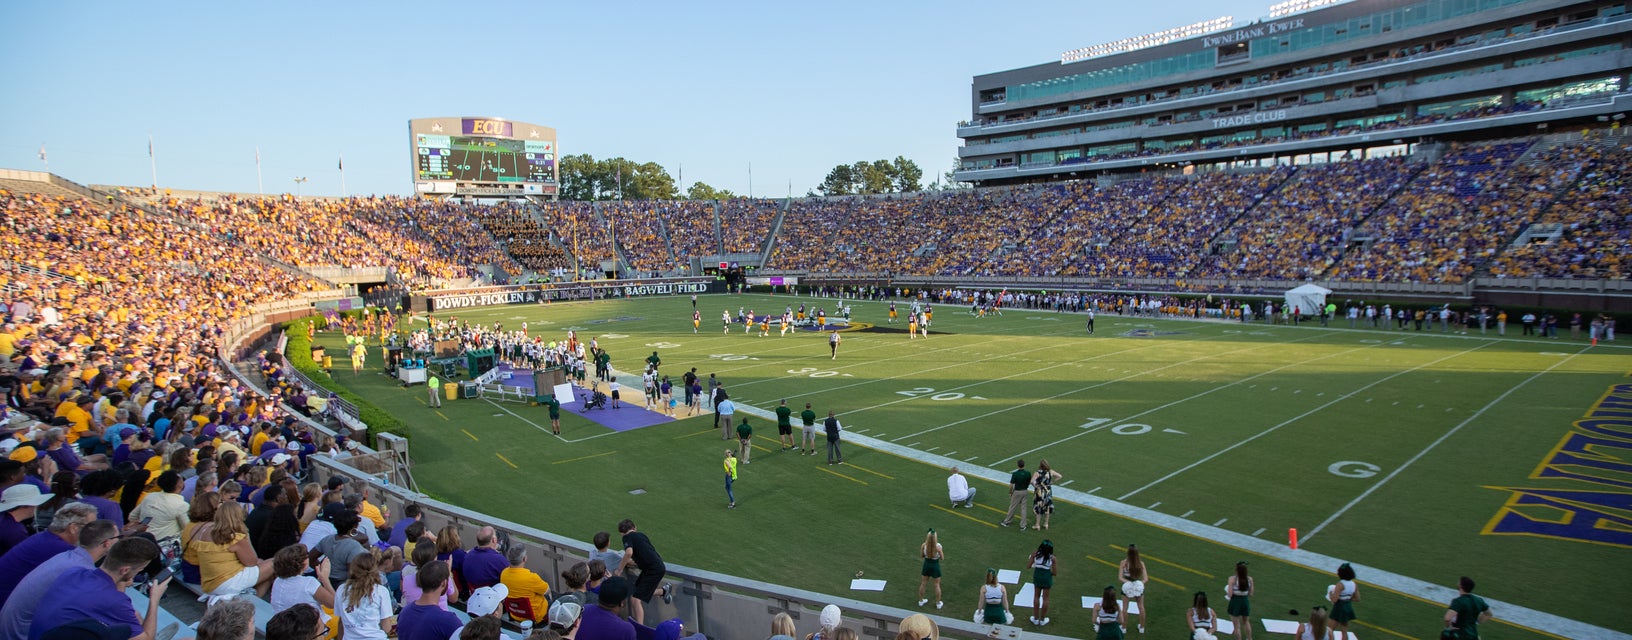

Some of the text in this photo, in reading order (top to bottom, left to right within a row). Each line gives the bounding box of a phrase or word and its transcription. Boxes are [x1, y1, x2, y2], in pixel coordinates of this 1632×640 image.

[472, 119, 505, 135] ECU
[1212, 109, 1287, 129] TRADE CLUB
[436, 293, 524, 309] DOWDY-FICKLEN
[625, 283, 674, 295] BAGWELL
[678, 283, 707, 293] FIELD
[787, 367, 839, 378] 30
[895, 387, 966, 401] 20
[1078, 417, 1153, 435] 10
[1327, 460, 1382, 478] G
